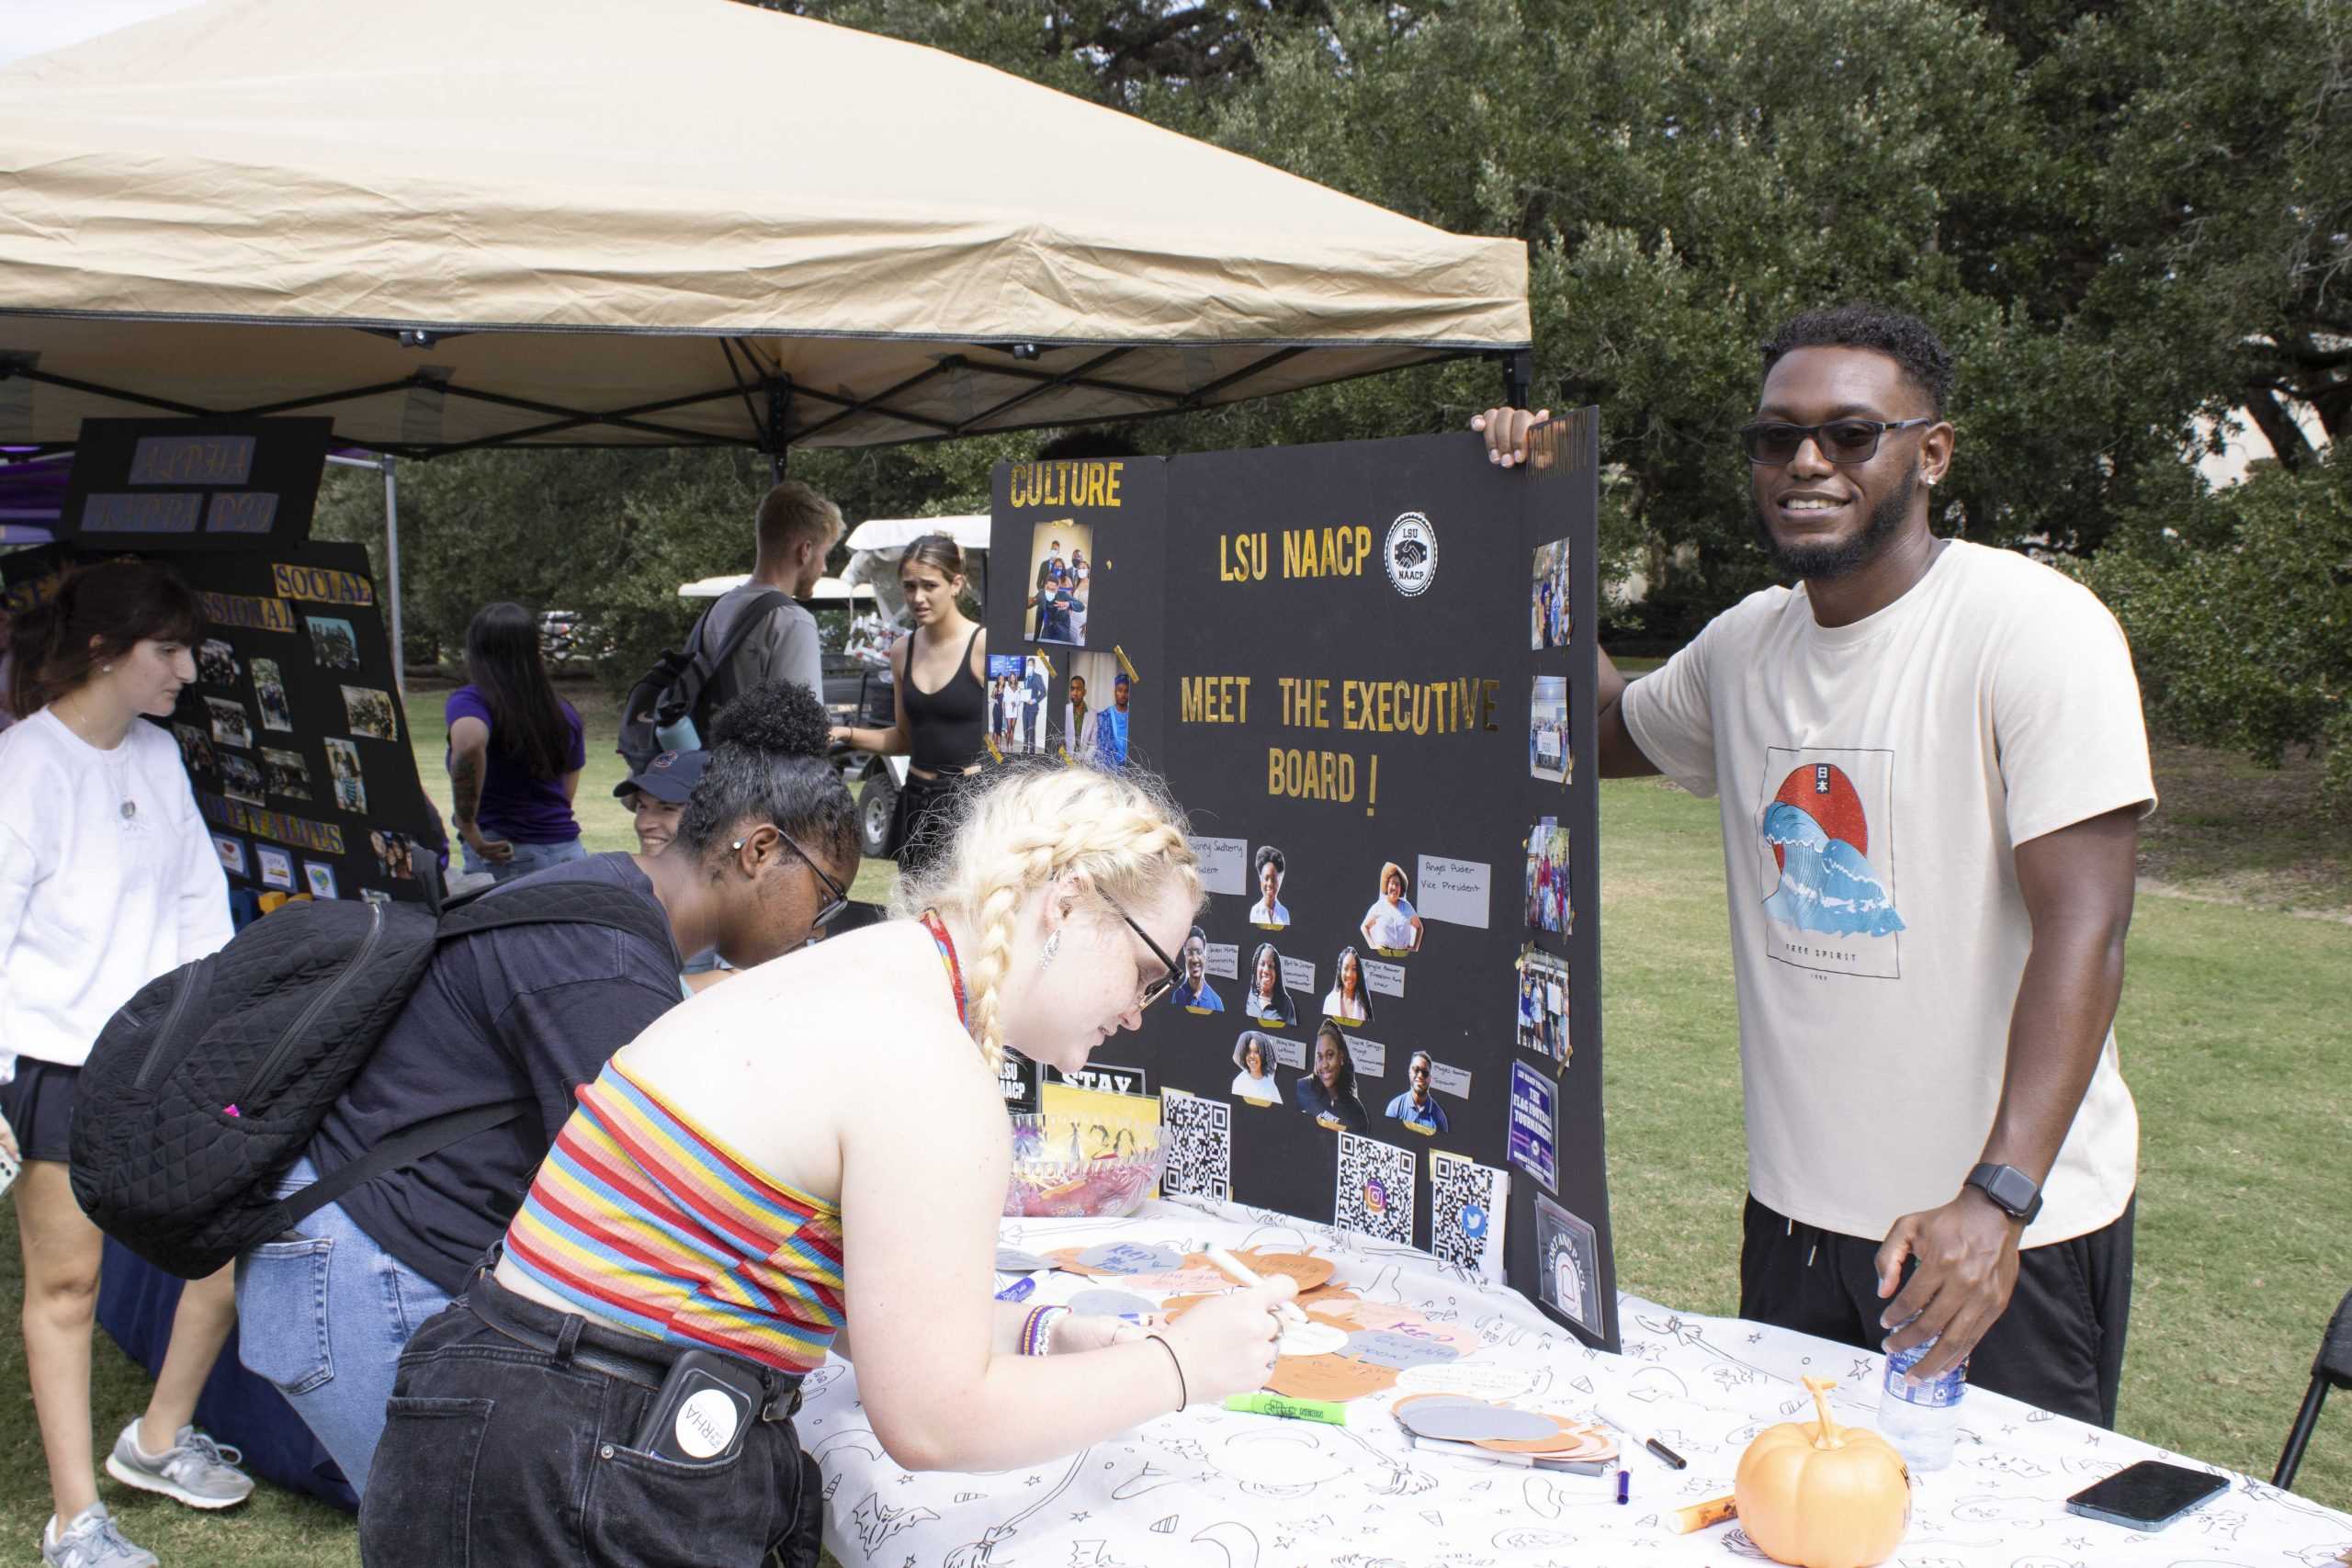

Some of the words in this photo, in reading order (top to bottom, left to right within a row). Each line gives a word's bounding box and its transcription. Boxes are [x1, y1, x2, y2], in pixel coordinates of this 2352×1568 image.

[1011, 462, 1124, 507] CULTURE
[1403, 528, 1418, 538] LSU
[1220, 532, 1267, 582] LSU
[1283, 525, 1372, 579] NAACP
[277, 566, 372, 606] SOCIAL
[1399, 570, 1424, 581] NAACP
[1182, 676, 1250, 724] MEET
[1279, 677, 1330, 728] THE
[1342, 677, 1499, 735] EXECUTIVE
[1269, 748, 1355, 803] BOARD
[1816, 766, 1828, 792] 日本
[1420, 880, 1436, 890] Vice
[1442, 882, 1480, 893] President
[1815, 949, 1856, 962] SPIRIT
[1062, 1070, 1132, 1095] STAY
[1513, 1093, 1529, 1111] FLAG
